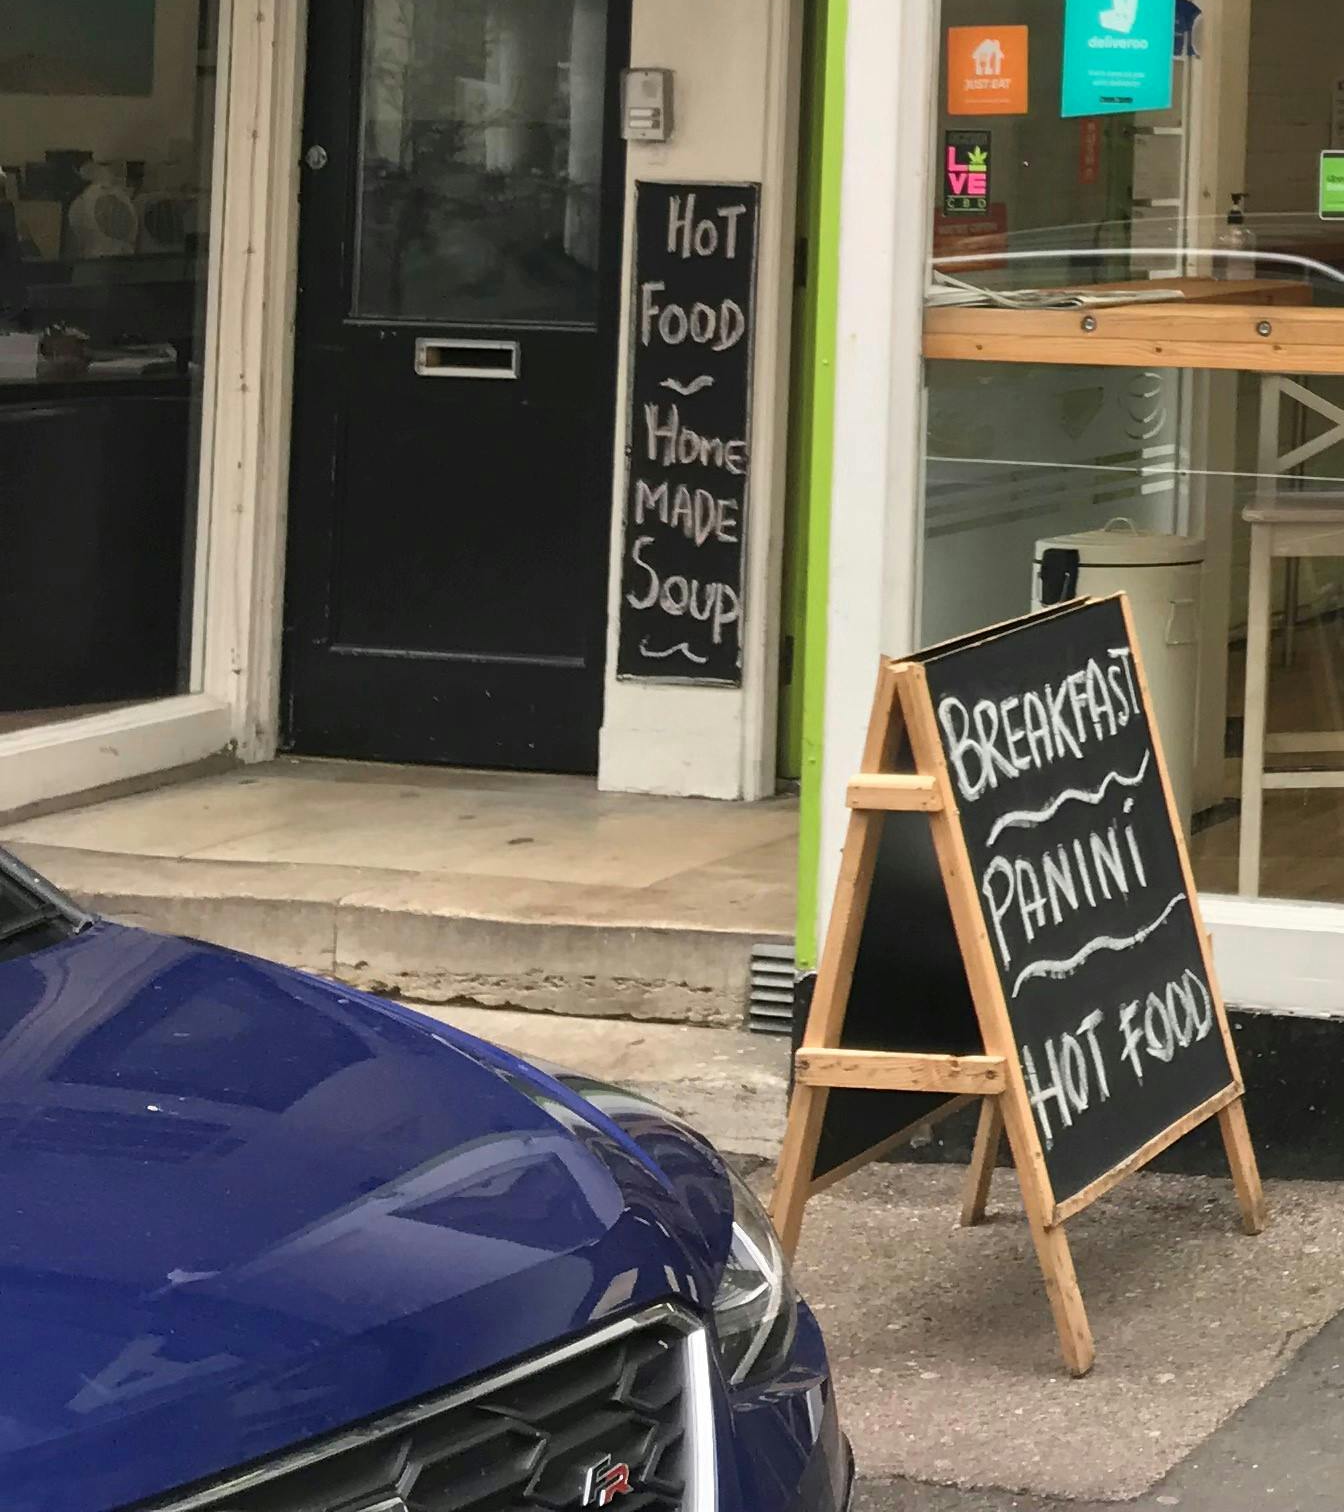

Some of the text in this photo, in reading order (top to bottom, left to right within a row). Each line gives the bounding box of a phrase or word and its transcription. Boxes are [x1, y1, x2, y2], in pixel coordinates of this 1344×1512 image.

[1087, 35, 1149, 49] deliveroo
[641, 281, 745, 352] FOOD
[635, 479, 739, 547] MADE
[938, 646, 1140, 803] BREAKFAST
[1022, 968, 1214, 1150] HOT FOOD
[582, 1452, 634, 1507] FR
